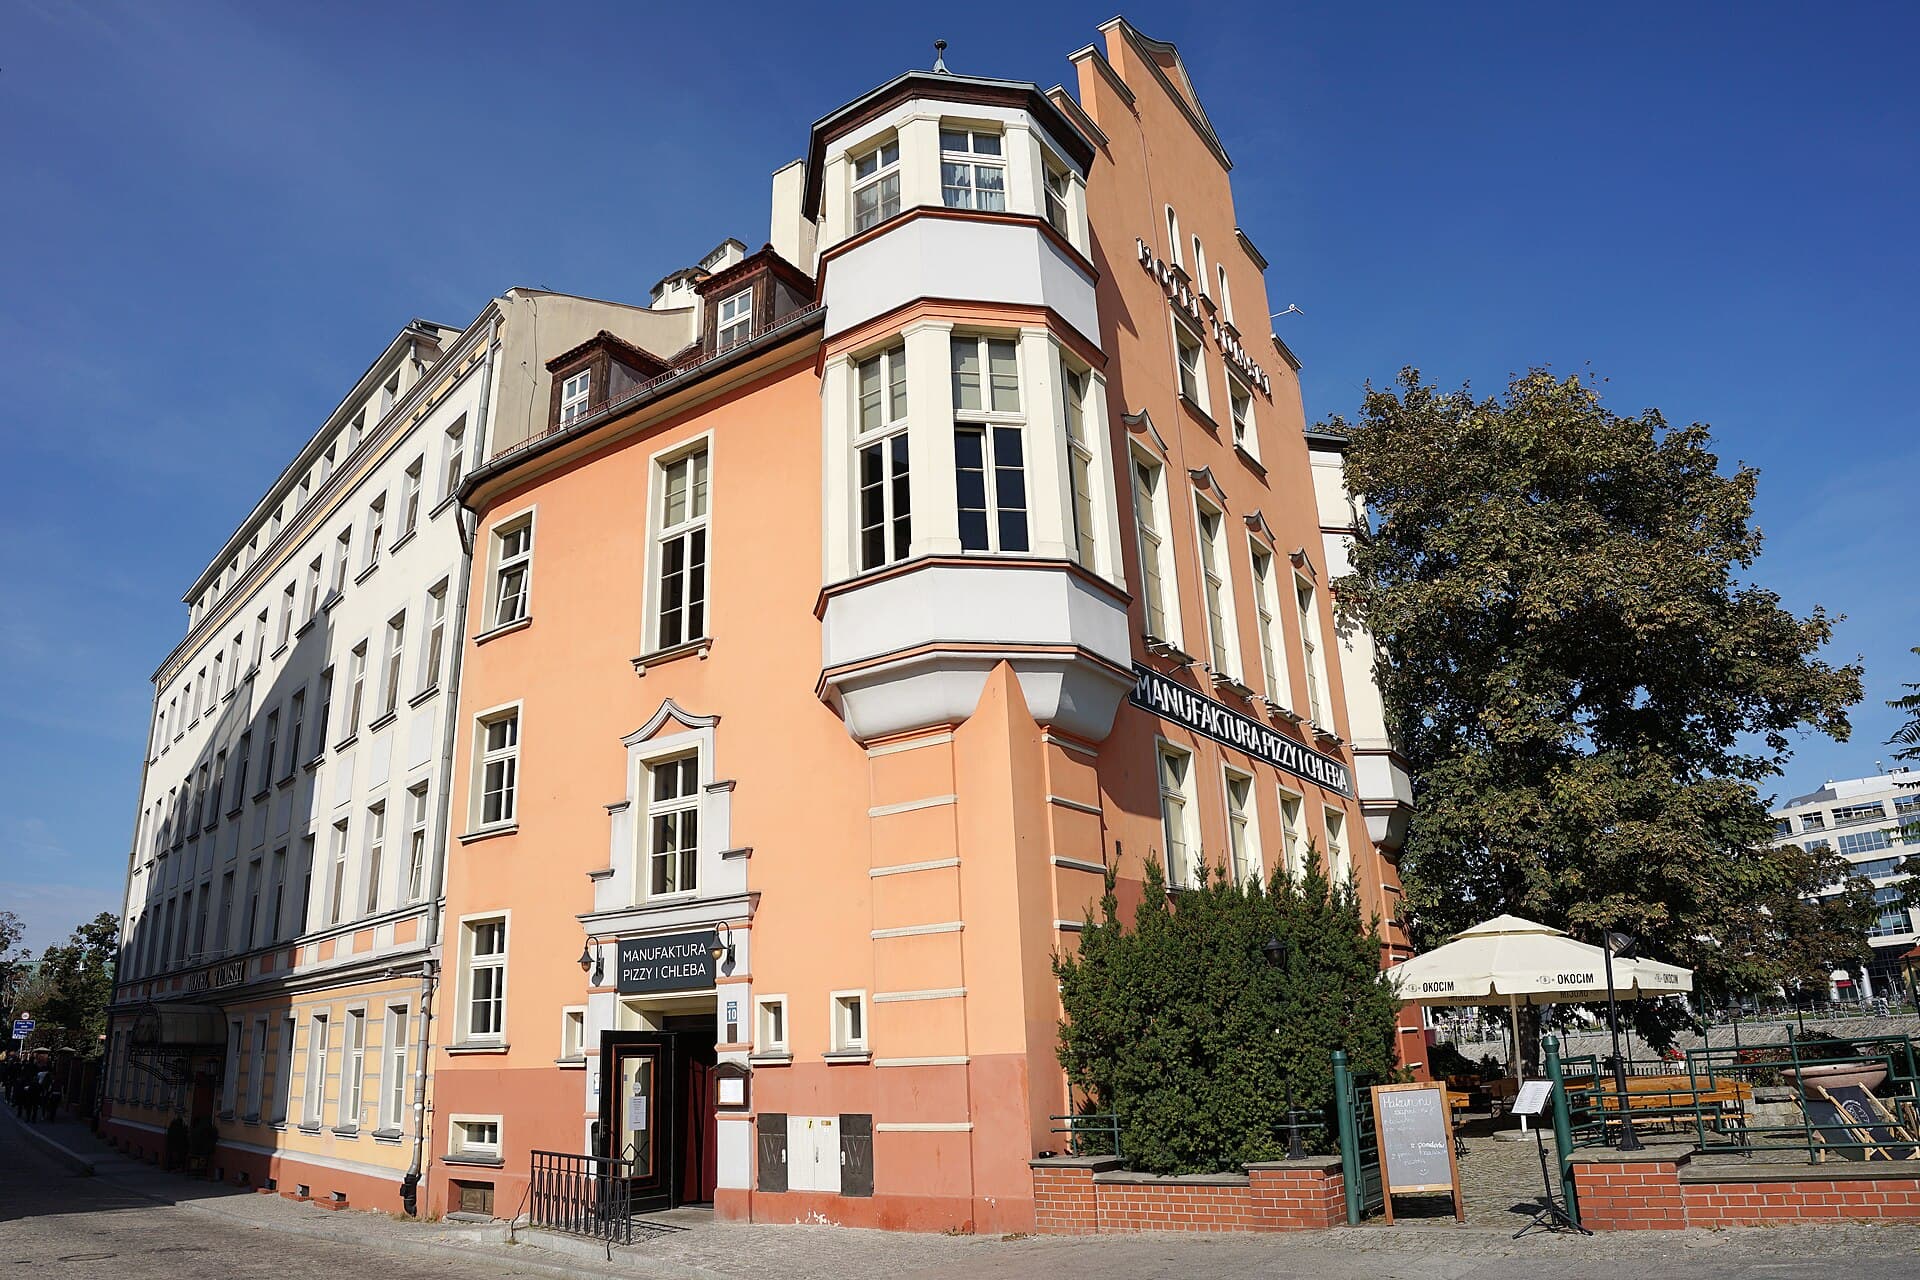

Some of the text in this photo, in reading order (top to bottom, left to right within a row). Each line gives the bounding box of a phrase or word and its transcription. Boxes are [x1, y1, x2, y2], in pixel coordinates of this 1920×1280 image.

[1136, 674, 1349, 793] MANUFAKTURA PIZZY I CHLEBA
[623, 942, 707, 963] MANUFAKTURA
[623, 963, 706, 982] PIZZY I CHLEBA
[1556, 973, 1594, 985] OKOCIM
[1663, 974, 1679, 984] OKOCIM
[1422, 981, 1455, 993] OKOCIM
[728, 1009, 737, 1020] 10
